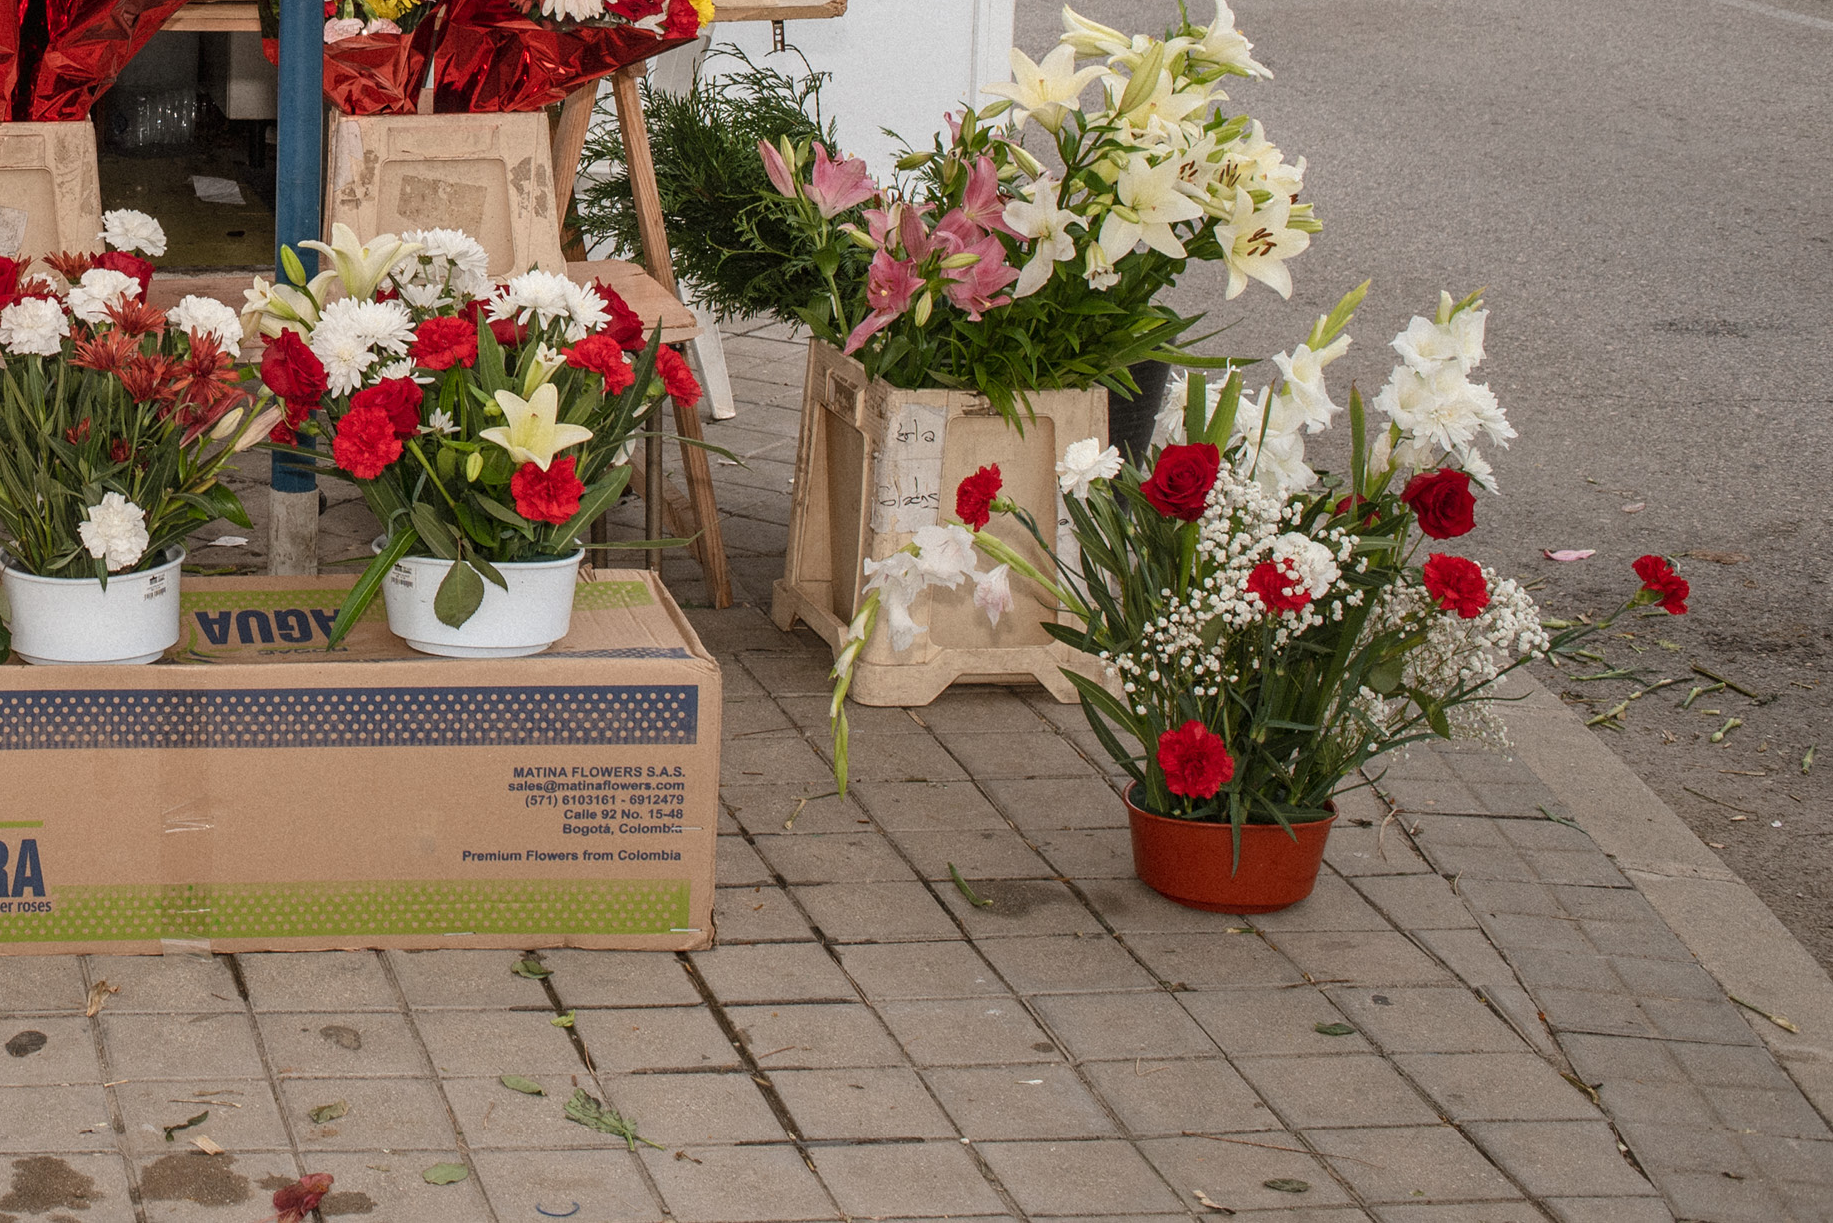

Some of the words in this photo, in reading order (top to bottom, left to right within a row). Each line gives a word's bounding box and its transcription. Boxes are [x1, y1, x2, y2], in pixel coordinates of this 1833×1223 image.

[194, 607, 346, 645] AGUA
[513, 767, 568, 778] MATINA
[571, 766, 643, 778] FLOWERS
[646, 766, 686, 777] S.A.S.
[508, 780, 685, 793] sales@matinaflowers.com
[525, 794, 558, 808] (571)
[562, 794, 616, 806] 6103161
[629, 794, 684, 805] 6912479
[563, 809, 597, 820] Calle
[601, 809, 616, 820] 92
[621, 809, 643, 819] No.
[648, 809, 683, 819] 15-48
[562, 823, 615, 836] Bogotá,
[618, 823, 682, 834] Colombia
[462, 850, 522, 862] Premium
[526, 850, 579, 861] Flowers
[582, 850, 614, 861] from
[618, 850, 682, 861] Colombia
[17, 900, 52, 914] roses
